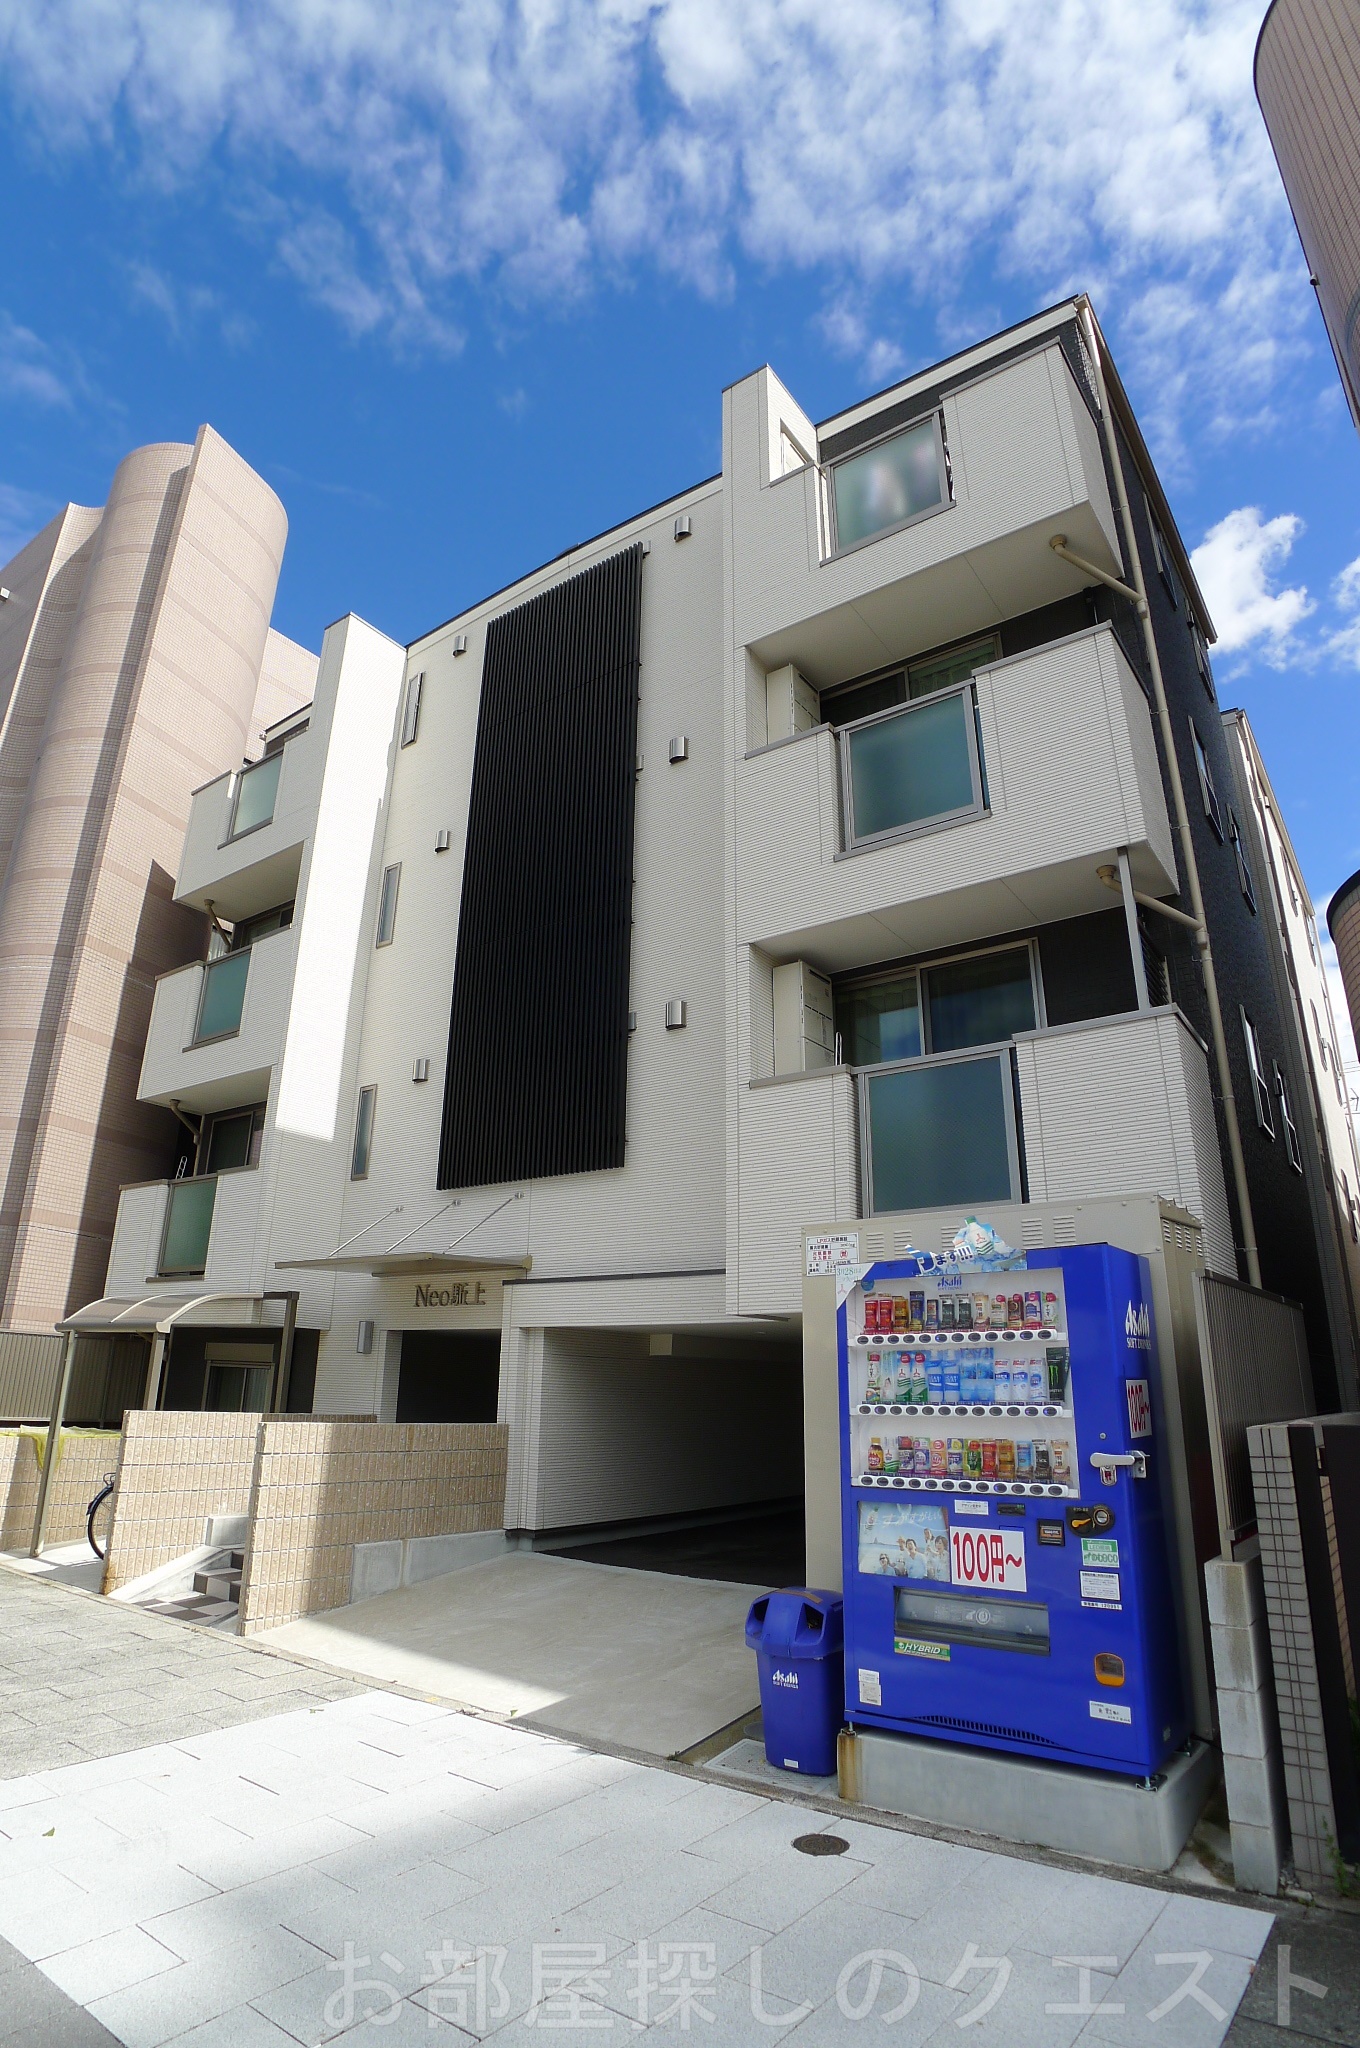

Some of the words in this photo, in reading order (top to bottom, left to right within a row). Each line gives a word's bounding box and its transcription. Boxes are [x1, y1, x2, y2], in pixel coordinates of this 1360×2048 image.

[937, 1275, 962, 1288] Asahi
[1125, 1299, 1150, 1336] Asahi
[904, 1643, 941, 1654] HYBRID
[772, 1670, 798, 1684] Asahi
